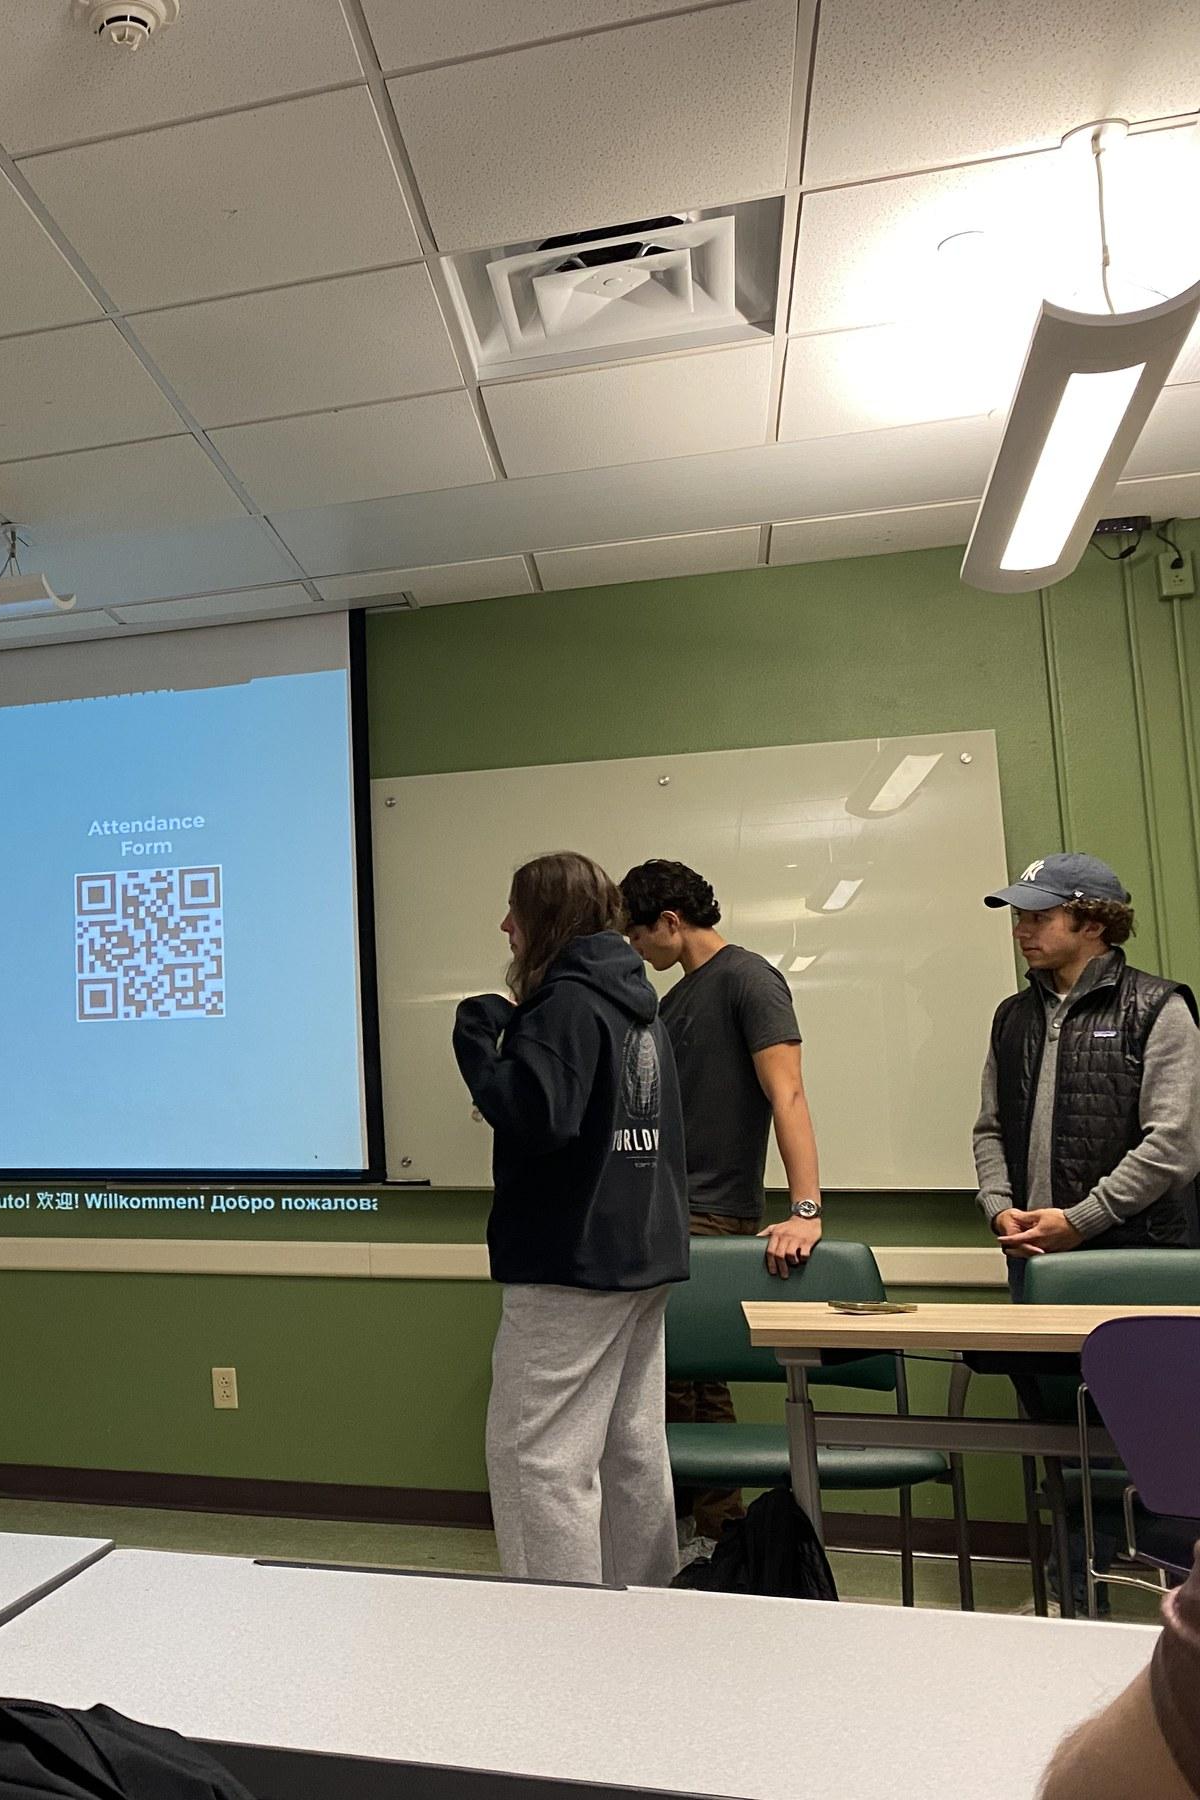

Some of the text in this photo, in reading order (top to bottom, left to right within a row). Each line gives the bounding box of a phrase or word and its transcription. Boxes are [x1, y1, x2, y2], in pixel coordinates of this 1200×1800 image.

[87, 815, 206, 836] Attendance
[121, 841, 173, 856] Form
[84, 1193, 205, 1210] Willkommen!
[210, 1195, 275, 1214] Добро
